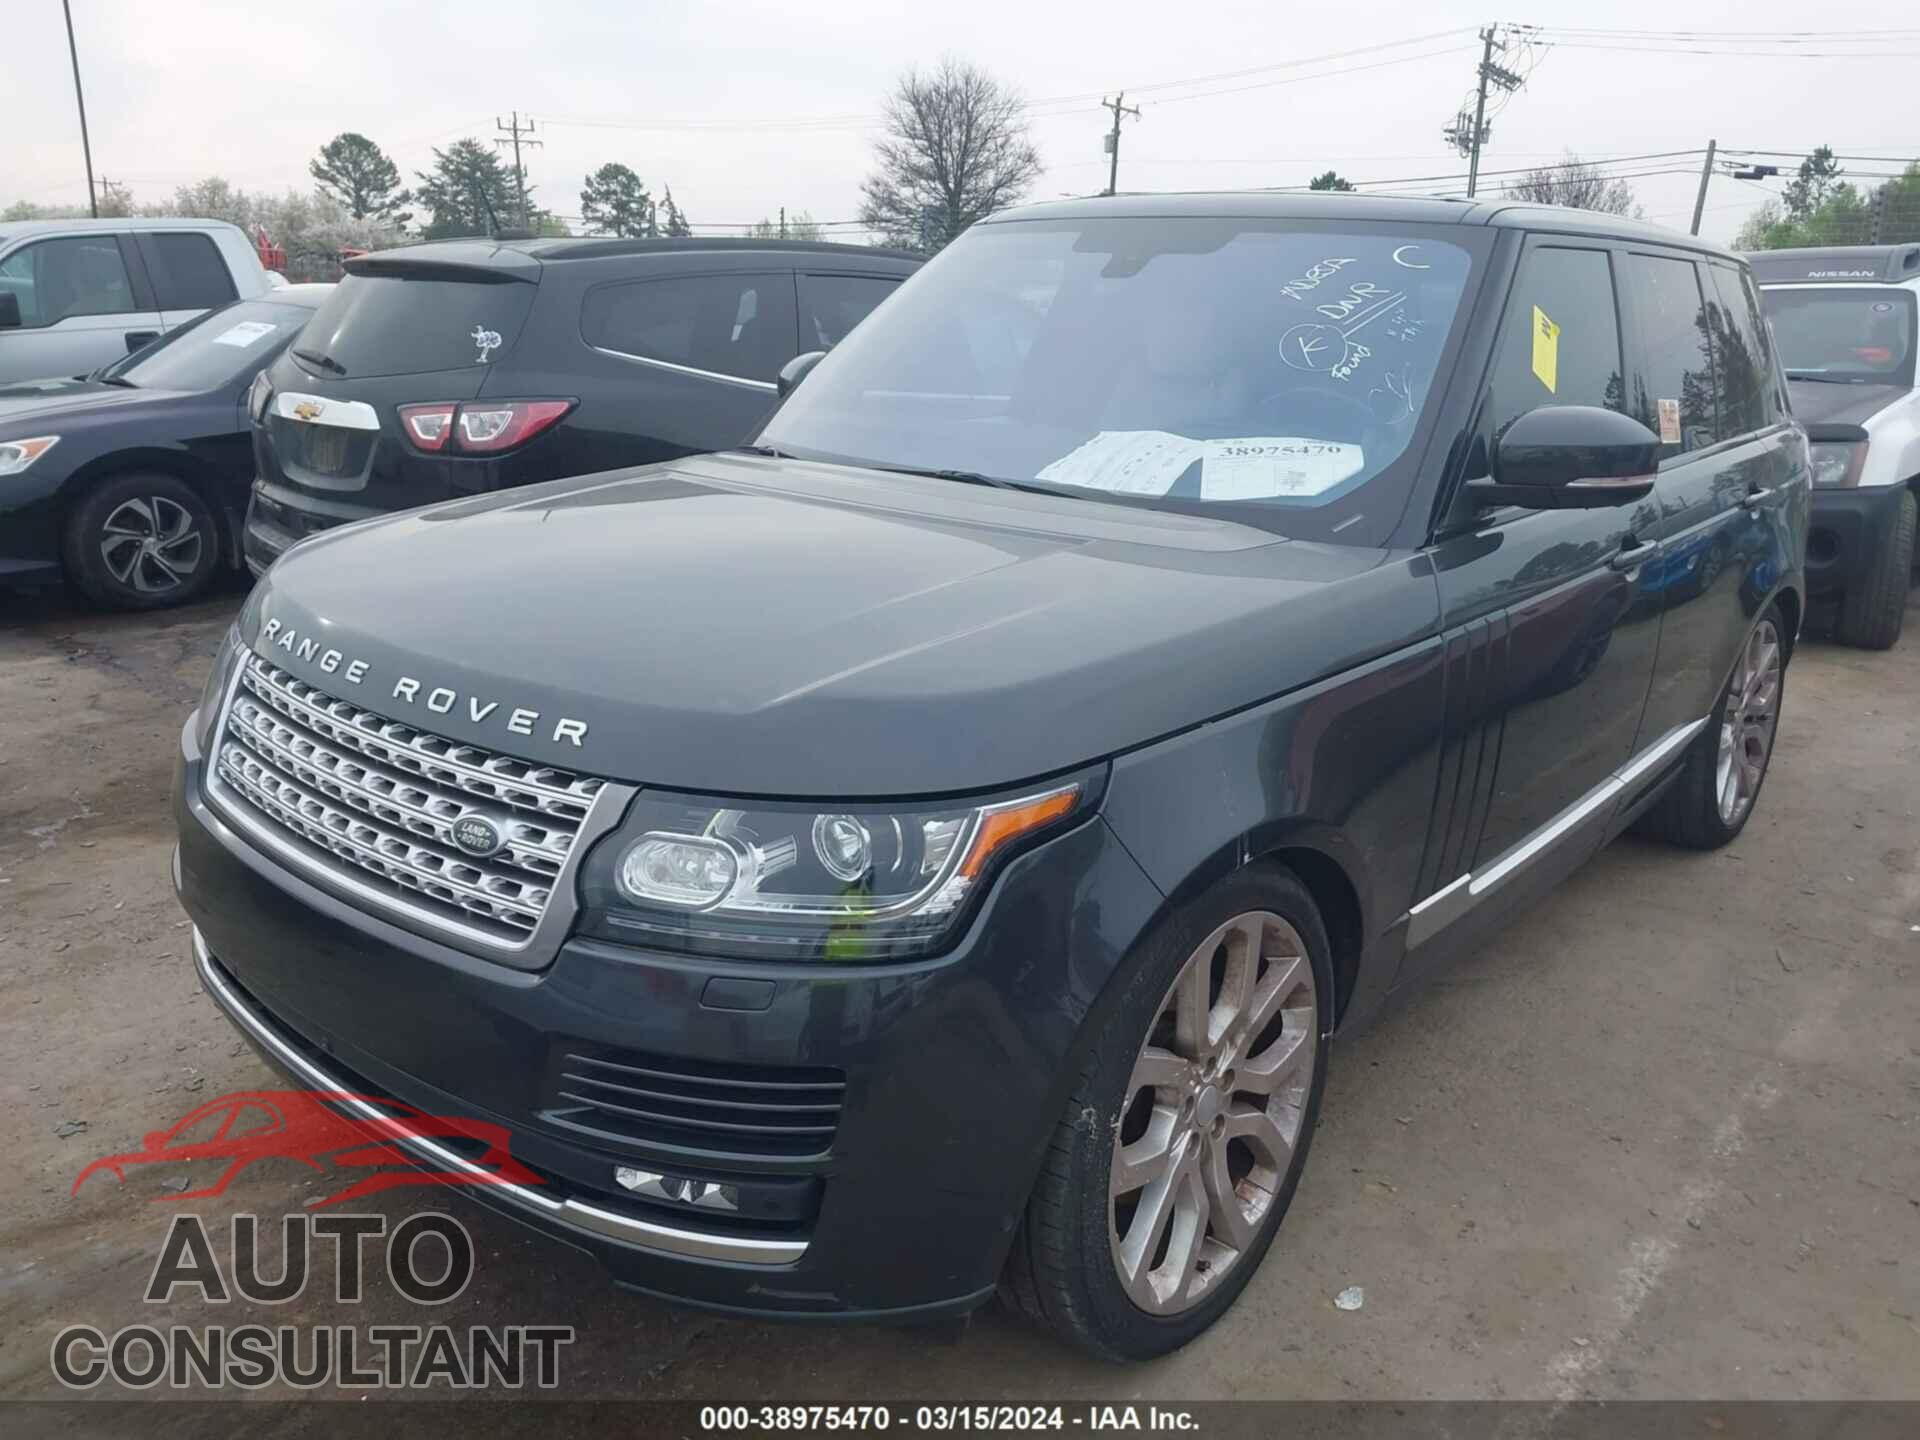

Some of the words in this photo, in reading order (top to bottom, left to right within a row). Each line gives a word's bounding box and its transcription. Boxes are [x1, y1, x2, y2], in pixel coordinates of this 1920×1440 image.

[1807, 270, 1875, 278] NISSAN
[1316, 282, 1390, 320] DNR
[1219, 446, 1342, 457] 38975470
[263, 617, 371, 685] RANGE
[392, 676, 589, 747] ROVER
[461, 822, 487, 837] LAND
[460, 832, 491, 850] ROVER
